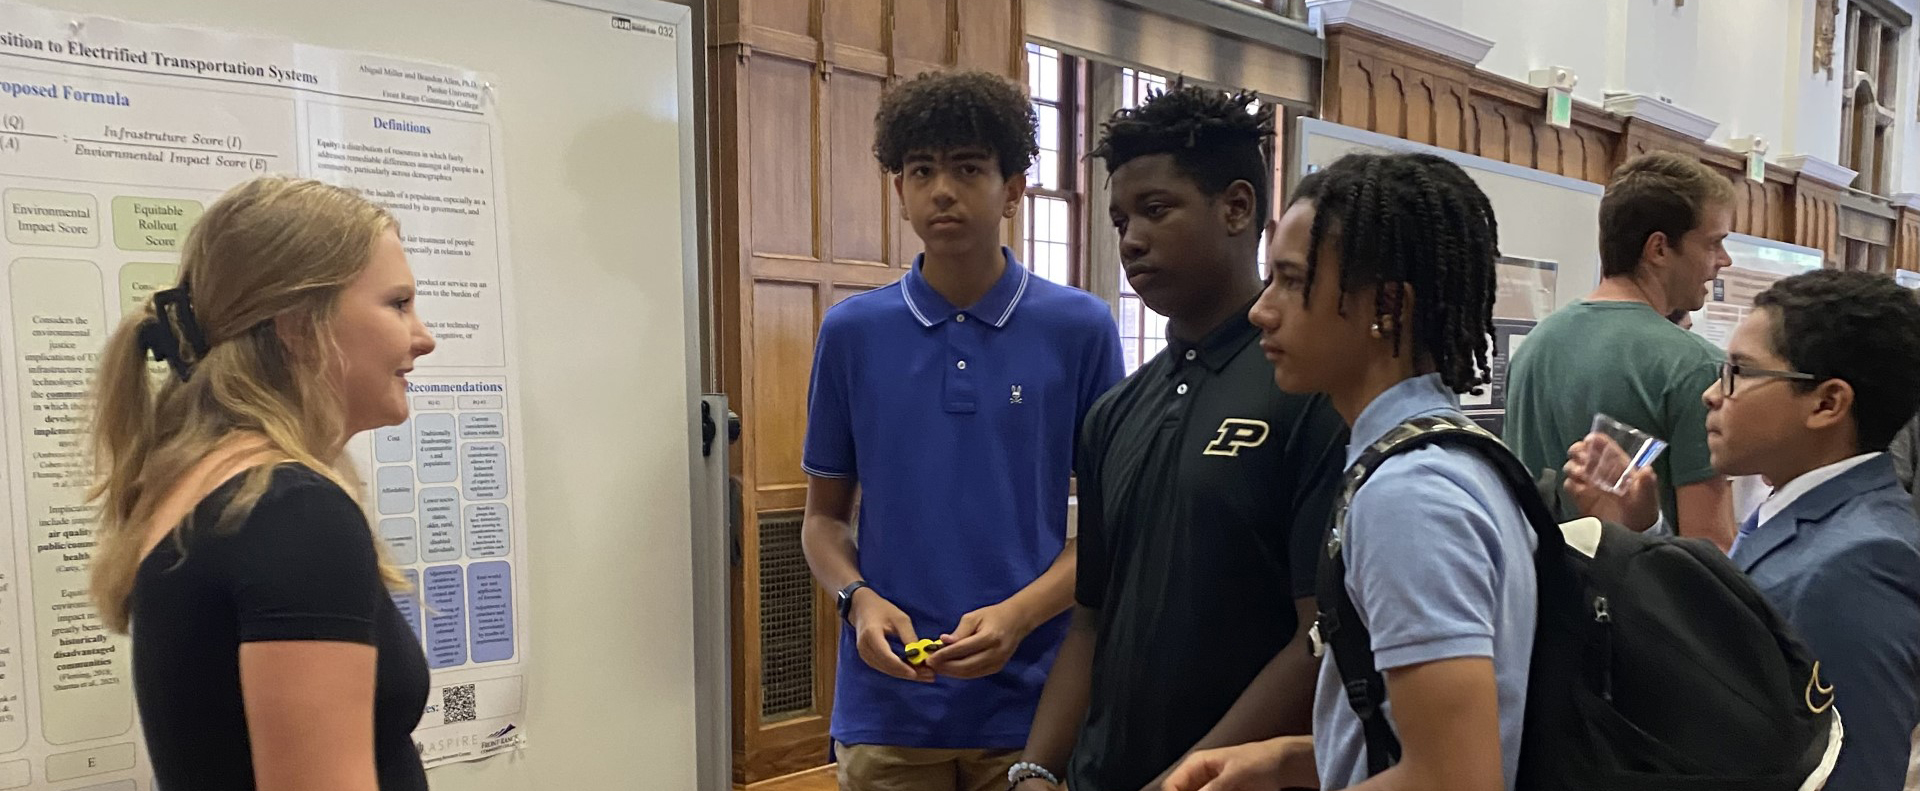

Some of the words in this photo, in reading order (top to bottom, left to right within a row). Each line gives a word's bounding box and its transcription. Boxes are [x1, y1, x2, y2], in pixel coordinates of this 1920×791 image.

[658, 25, 674, 38] 032
[0, 31, 43, 51] sition
[49, 40, 63, 54] to
[67, 40, 148, 65] Electrified
[151, 51, 264, 77] Transportation
[268, 64, 319, 85] Systems
[404, 71, 416, 80] and
[63, 85, 130, 107] Formula
[382, 89, 400, 99] Front
[400, 92, 420, 103] Range
[456, 100, 479, 111] College
[448, 88, 478, 101] University
[3, 113, 24, 131] (Q)
[373, 116, 432, 135] Definitions
[191, 133, 224, 147] Score
[347, 142, 384, 154] distribution
[430, 150, 447, 160] which
[170, 151, 210, 167] Impact
[215, 155, 247, 169] Score
[354, 166, 390, 178] particularly
[391, 169, 411, 178] across
[443, 163, 451, 171] all
[451, 165, 471, 174] people
[375, 188, 395, 199] health
[396, 190, 404, 199] of
[442, 194, 472, 206] especially
[12, 203, 91, 219] Environmental
[134, 203, 184, 217] Equitable
[413, 202, 421, 212] by
[431, 205, 467, 216] government,
[468, 208, 480, 216] and
[18, 220, 56, 234] Impact
[58, 222, 88, 235] Score
[138, 219, 178, 232] Rollout
[145, 236, 176, 247] Score
[407, 235, 418, 244] fair
[419, 235, 446, 245] treatment
[455, 239, 475, 248] people
[440, 248, 463, 257] relation
[464, 249, 471, 257] to
[416, 279, 439, 287] product
[447, 280, 468, 288] service
[440, 289, 450, 297] the
[450, 290, 472, 298] burden
[472, 291, 481, 299] of
[32, 315, 74, 324] Considers
[75, 316, 88, 324] the
[446, 321, 480, 331] technology
[32, 328, 90, 337] environmental
[48, 339, 76, 351] justice
[25, 353, 75, 363] implications
[76, 353, 86, 361] of
[28, 365, 84, 373] infrastructure
[32, 378, 84, 387] technologies
[406, 381, 503, 393] Recommendations
[31, 391, 43, 399] the
[43, 402, 69, 411] which
[387, 434, 401, 442] Cost
[1202, 418, 1270, 457] P
[39, 518, 69, 527] include
[48, 530, 60, 538] air
[62, 528, 92, 539] quality
[63, 552, 90, 561] health
[57, 613, 85, 623] impact
[52, 625, 79, 637] greatly
[60, 634, 106, 646] historically
[54, 644, 115, 659] disadvantaged
[57, 659, 112, 671] communities
[429, 734, 478, 752] ASPIRE
[88, 757, 96, 768] E
